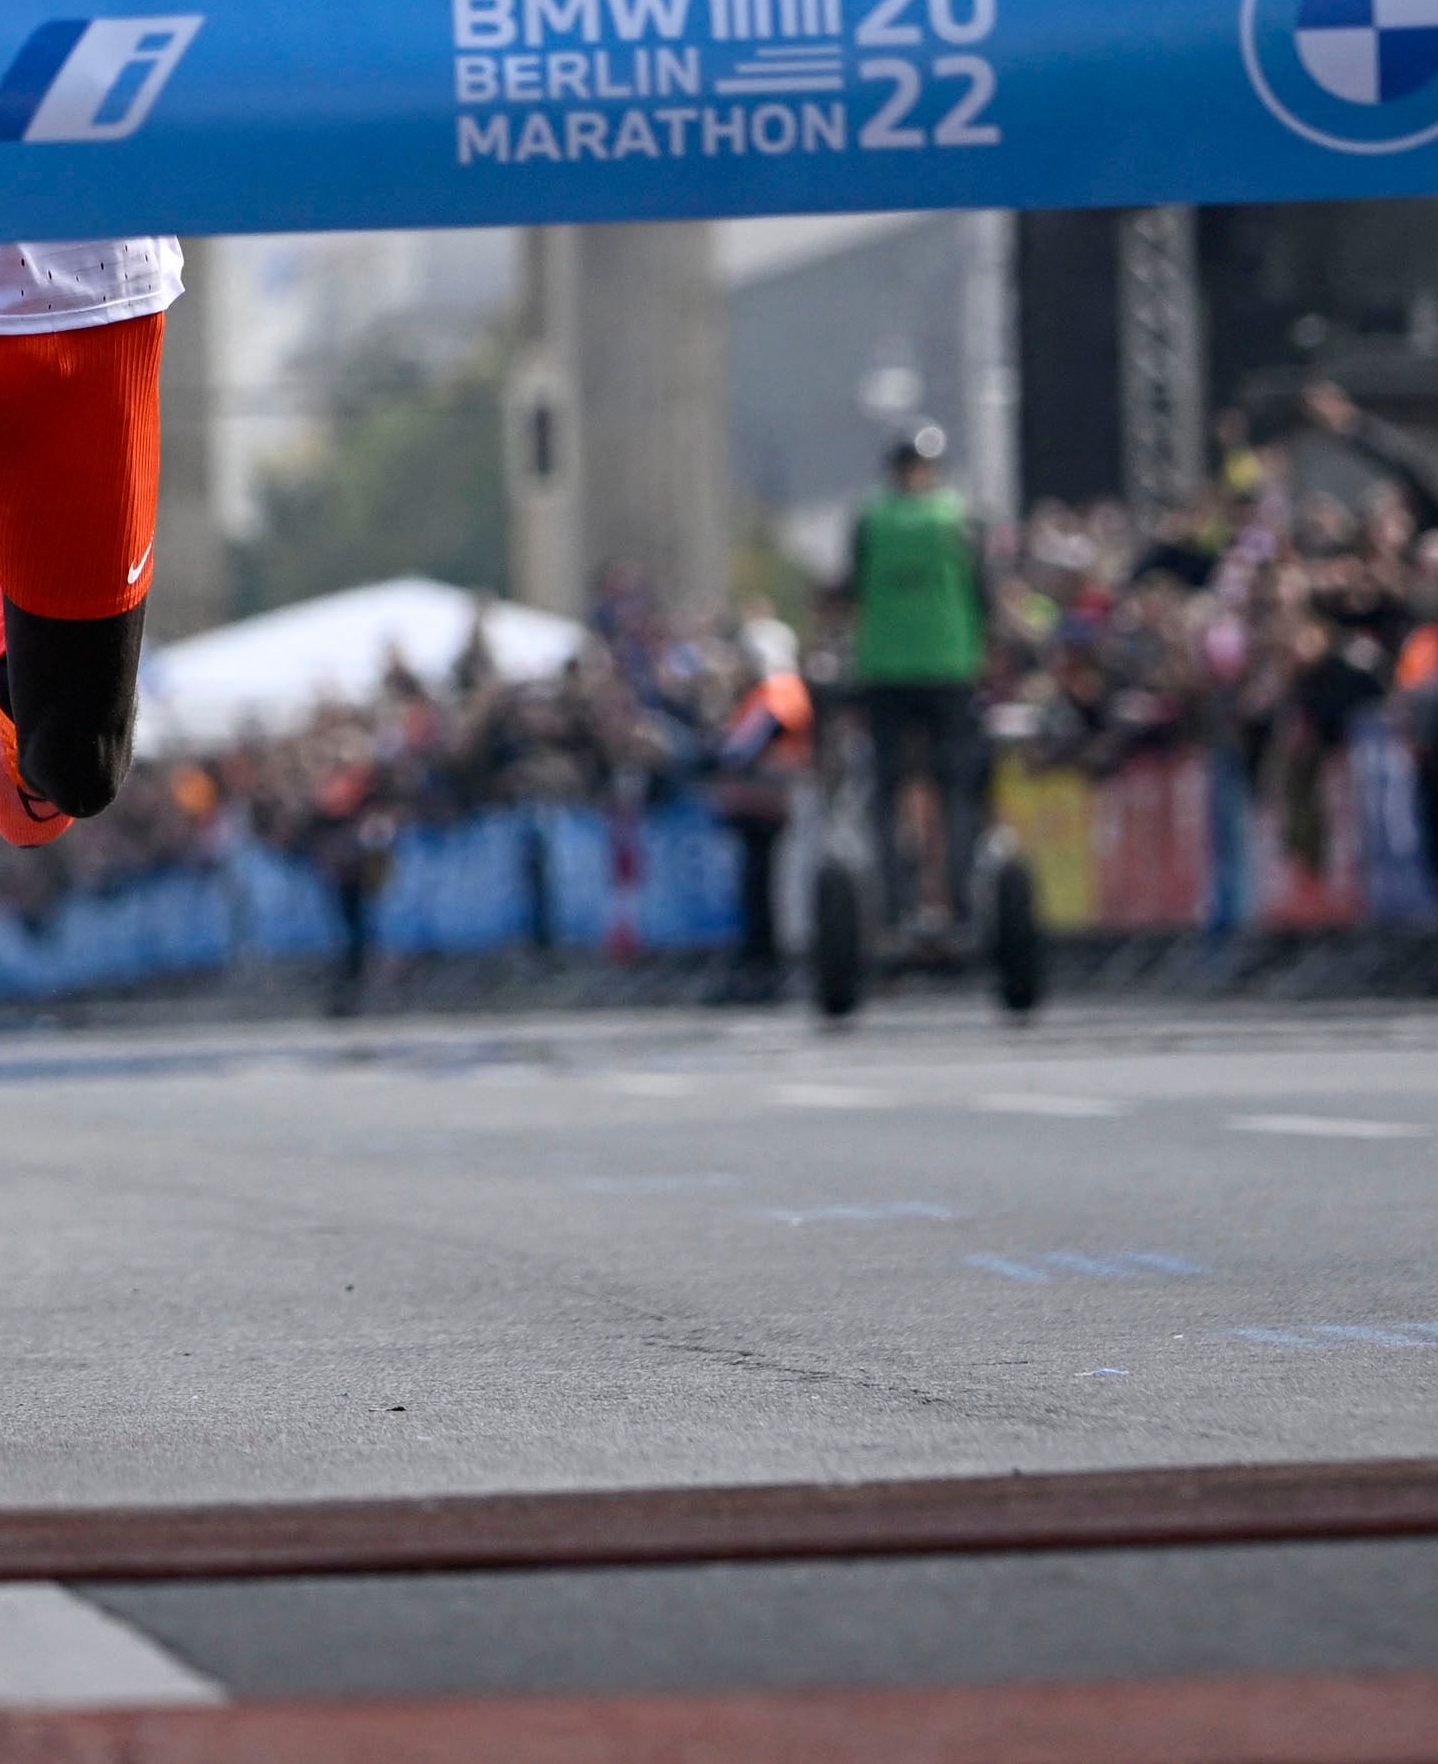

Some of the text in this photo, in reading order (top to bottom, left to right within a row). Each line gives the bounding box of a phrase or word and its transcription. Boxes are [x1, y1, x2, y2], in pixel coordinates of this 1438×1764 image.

[454, 46, 700, 103] BERLIN
[859, 55, 1002, 148] 22
[456, 102, 846, 165] MARATHON
